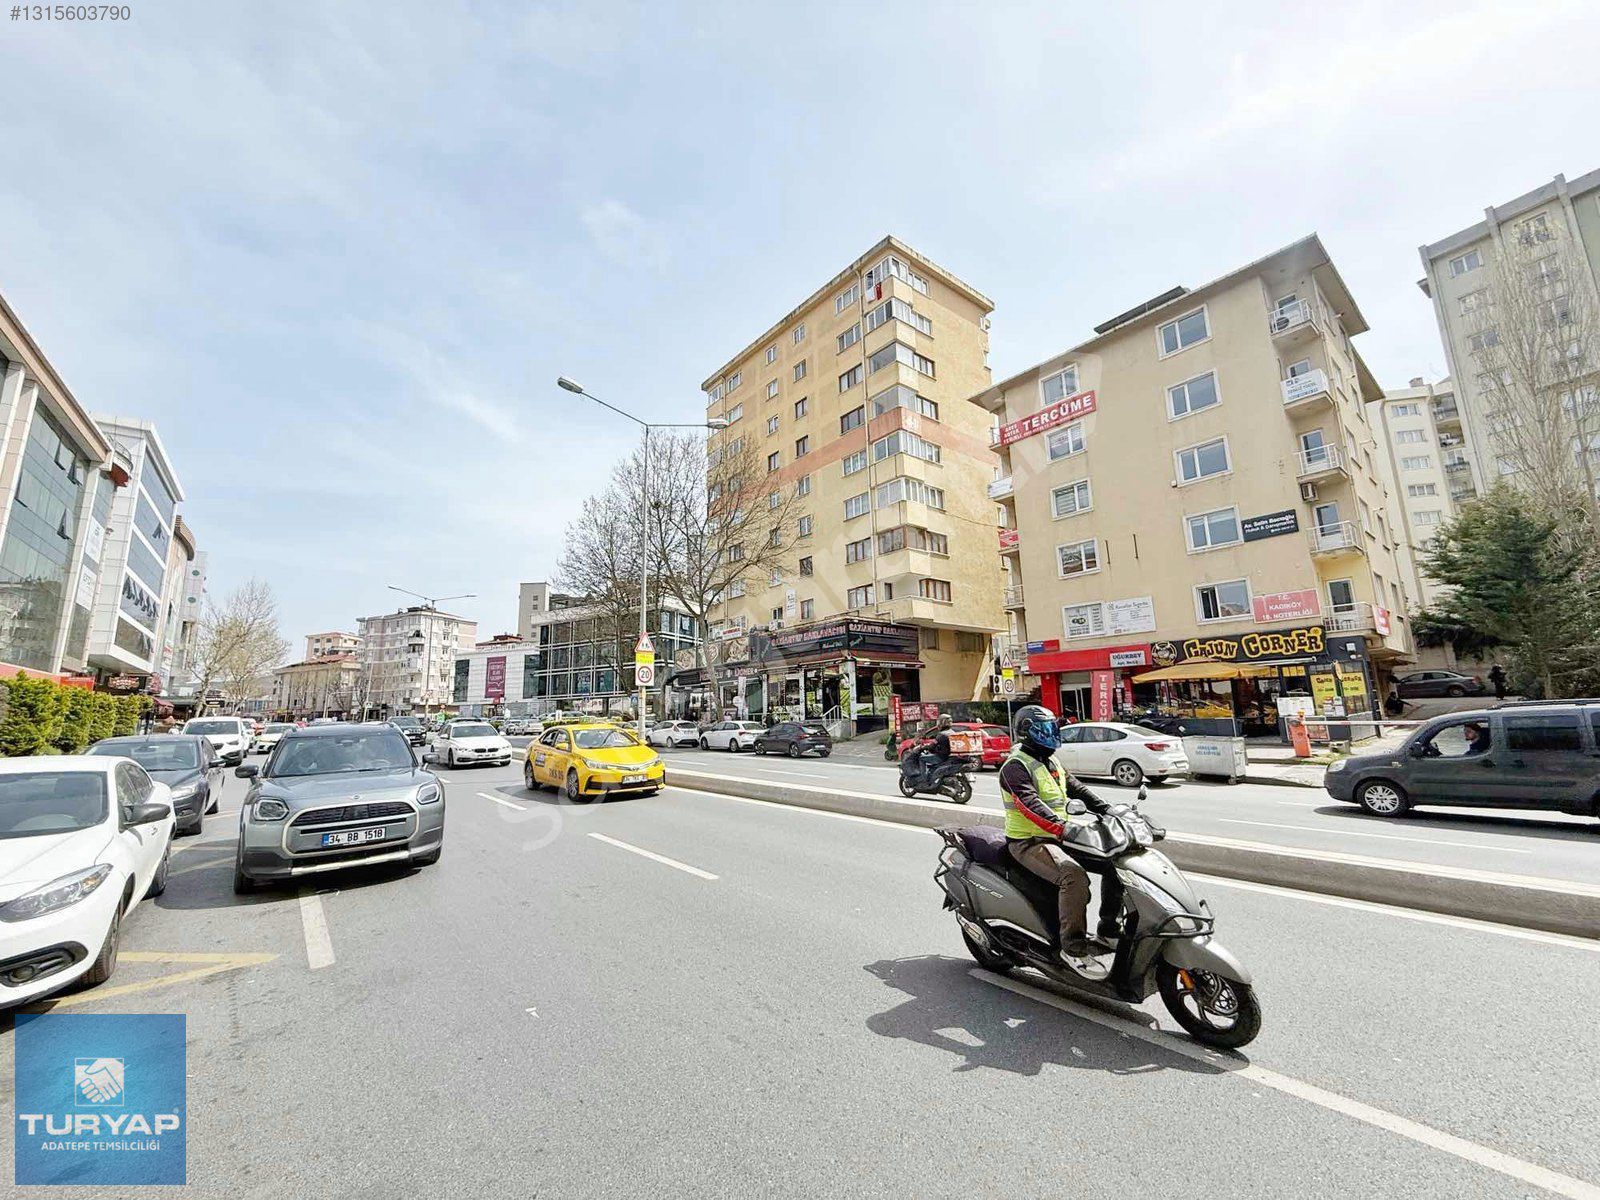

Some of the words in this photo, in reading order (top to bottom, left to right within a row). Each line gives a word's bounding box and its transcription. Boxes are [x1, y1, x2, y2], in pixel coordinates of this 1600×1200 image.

[1022, 394, 1092, 431] TERCÜME
[1268, 601, 1301, 610] KADIKÖY
[1273, 608, 1313, 619] NOTERLİĞİ
[1184, 639, 1237, 659] CAJUN
[1242, 630, 1323, 658] CORNER
[641, 670, 649, 679] 20
[329, 834, 341, 844] 34
[347, 832, 359, 842] BB
[364, 829, 383, 840] 1518
